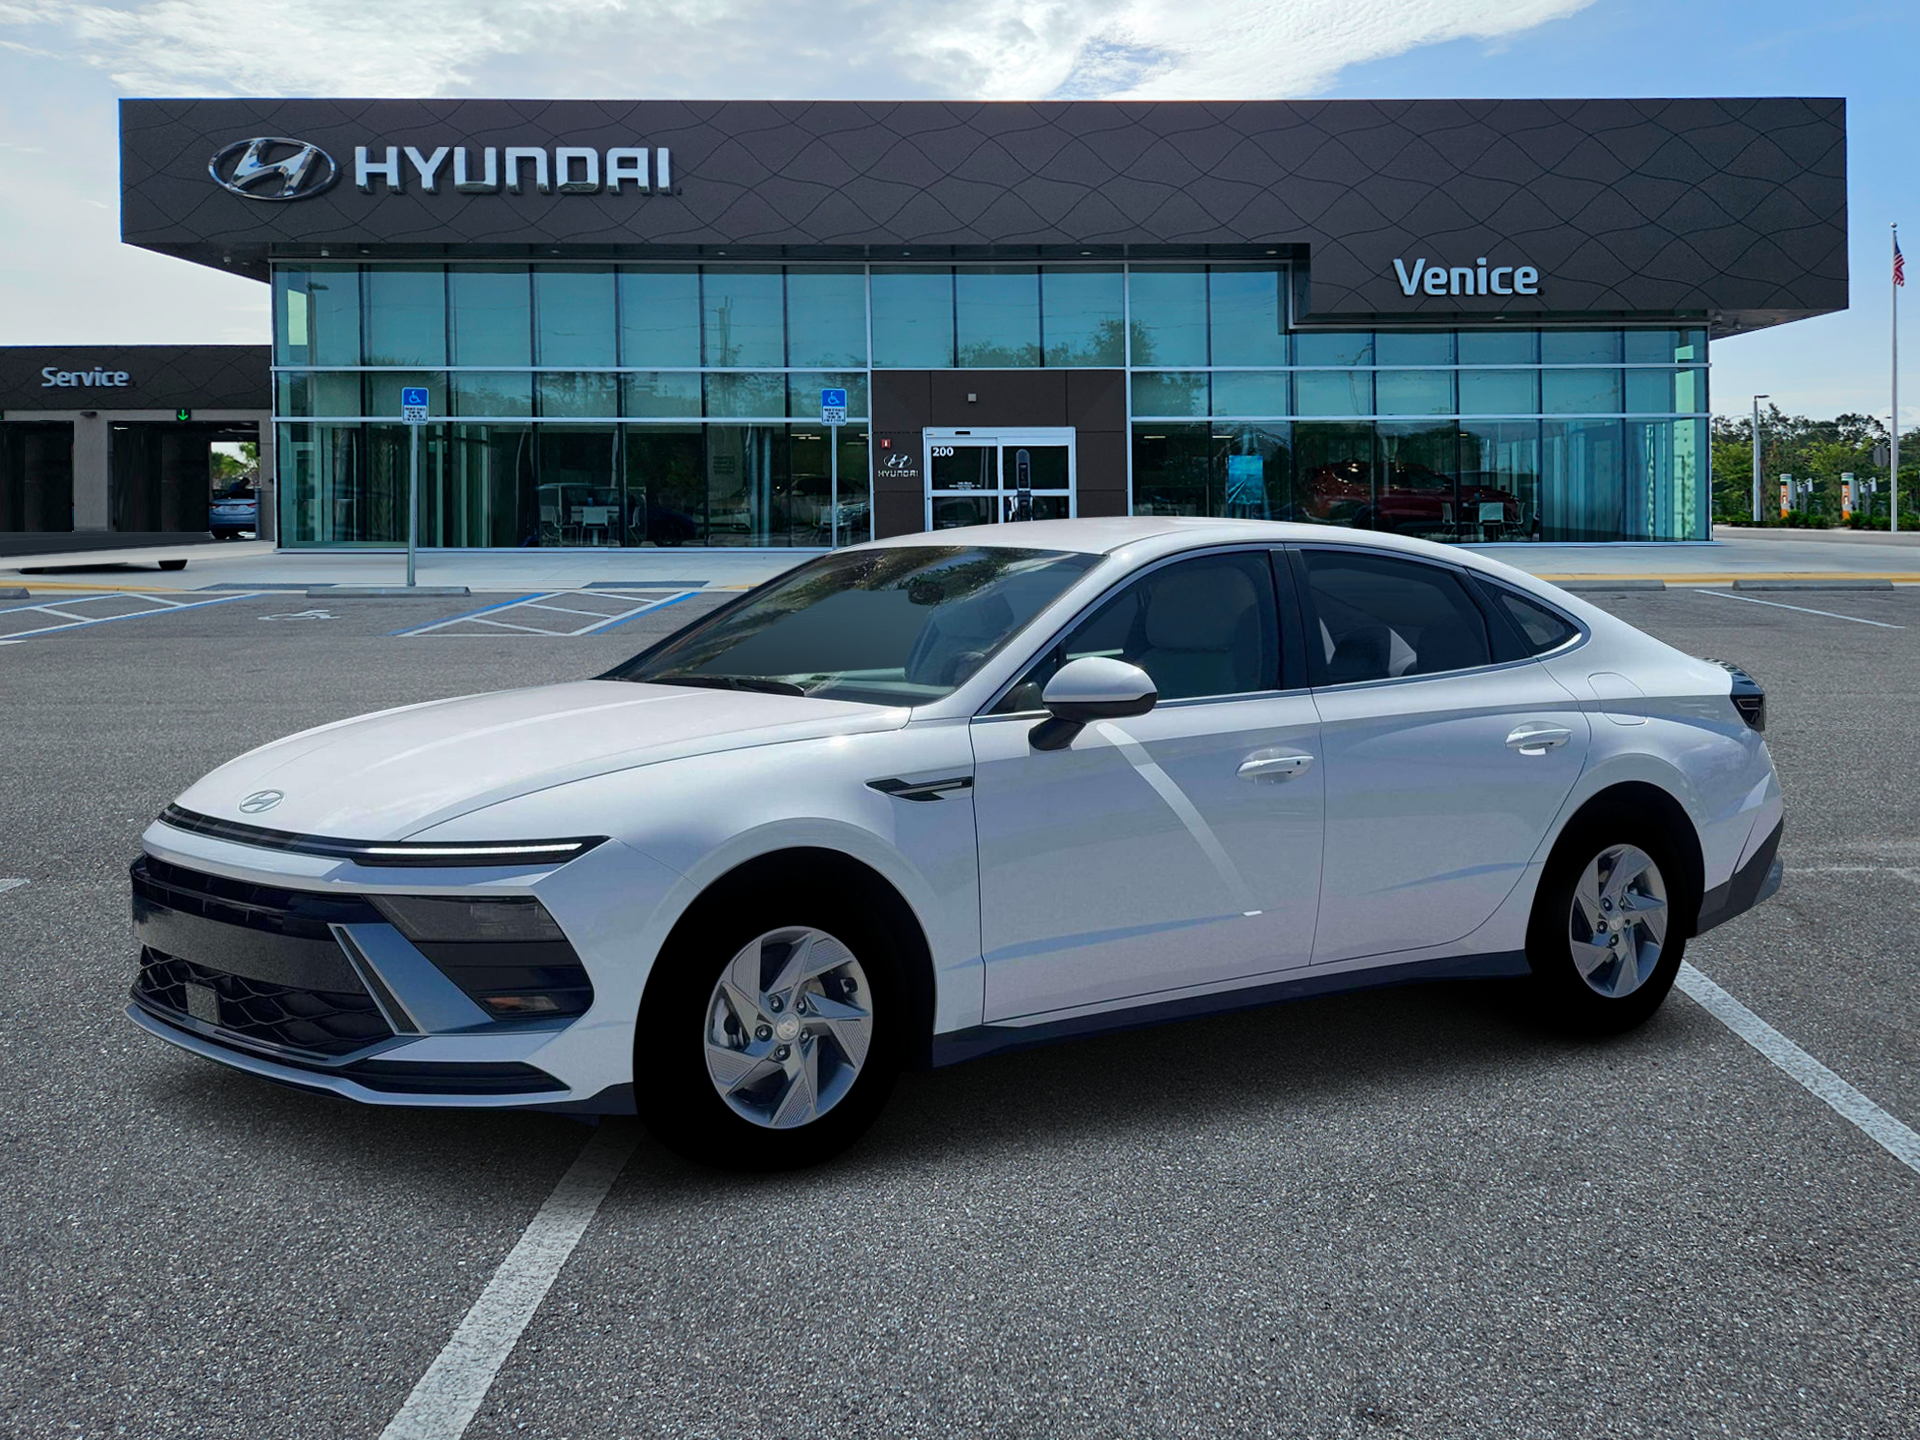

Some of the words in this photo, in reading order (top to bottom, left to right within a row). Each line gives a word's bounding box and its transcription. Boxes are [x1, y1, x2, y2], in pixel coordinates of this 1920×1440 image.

[354, 146, 670, 194] HYUNDAI
[1392, 257, 1539, 296] Venice
[41, 366, 130, 387] Service
[932, 446, 954, 457] 200
[877, 469, 919, 478] HYUNDAI
